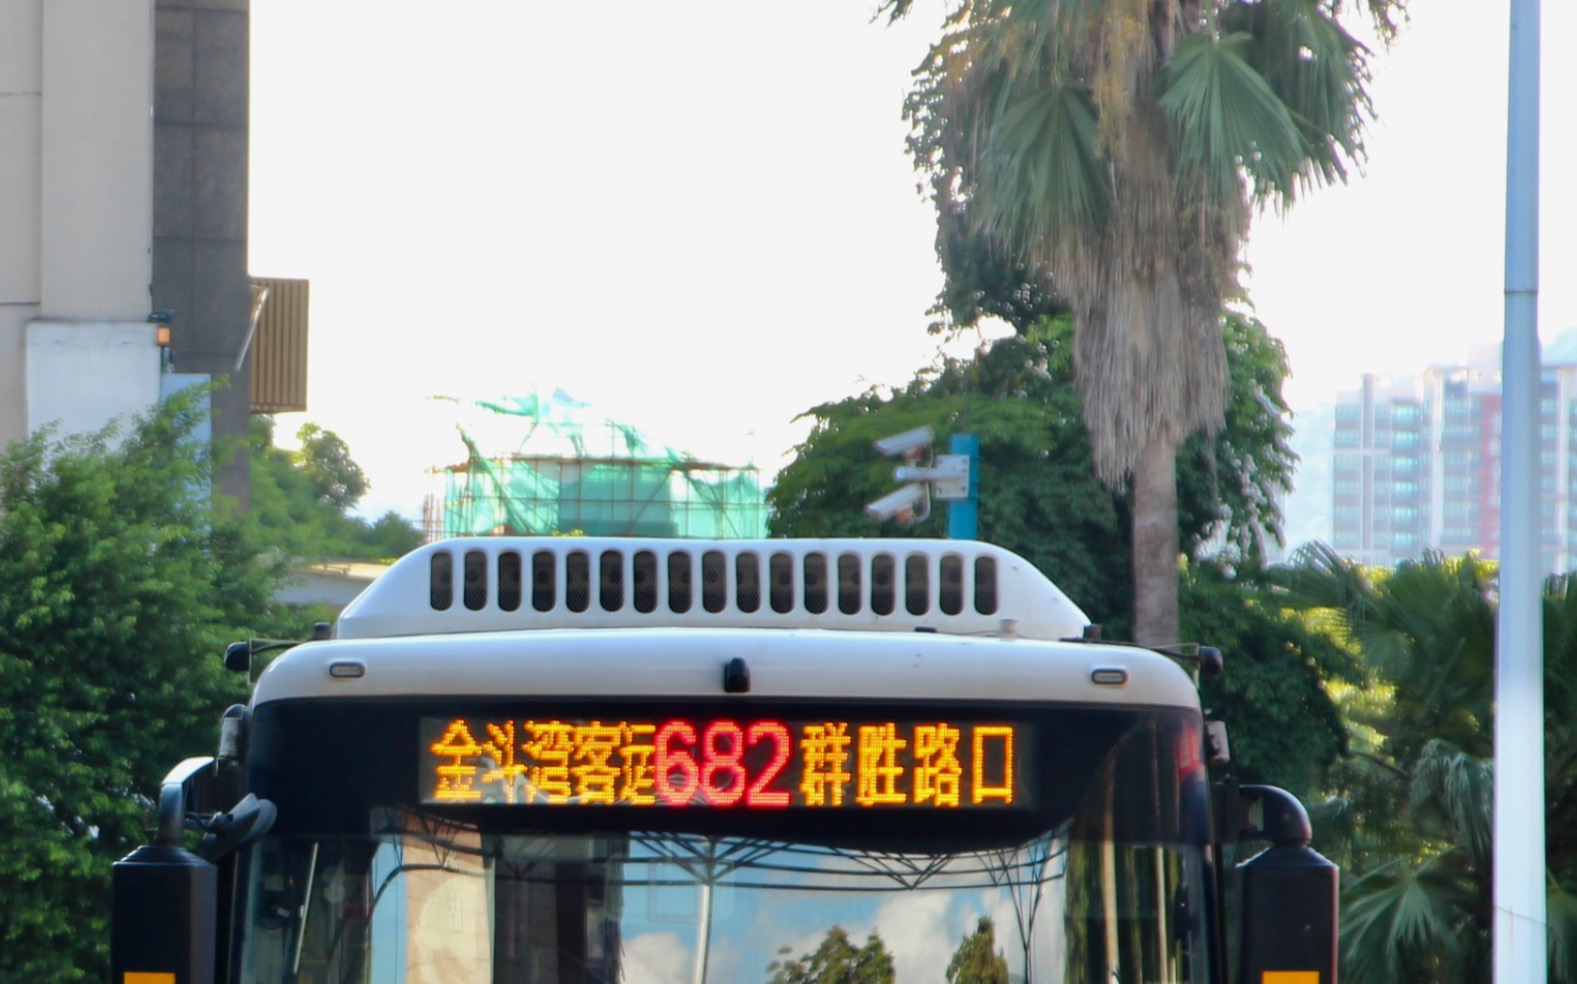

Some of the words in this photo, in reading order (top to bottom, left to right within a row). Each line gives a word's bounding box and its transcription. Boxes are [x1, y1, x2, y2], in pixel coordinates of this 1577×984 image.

[655, 718, 794, 807] 682
[800, 722, 1014, 807] 群胜路口
